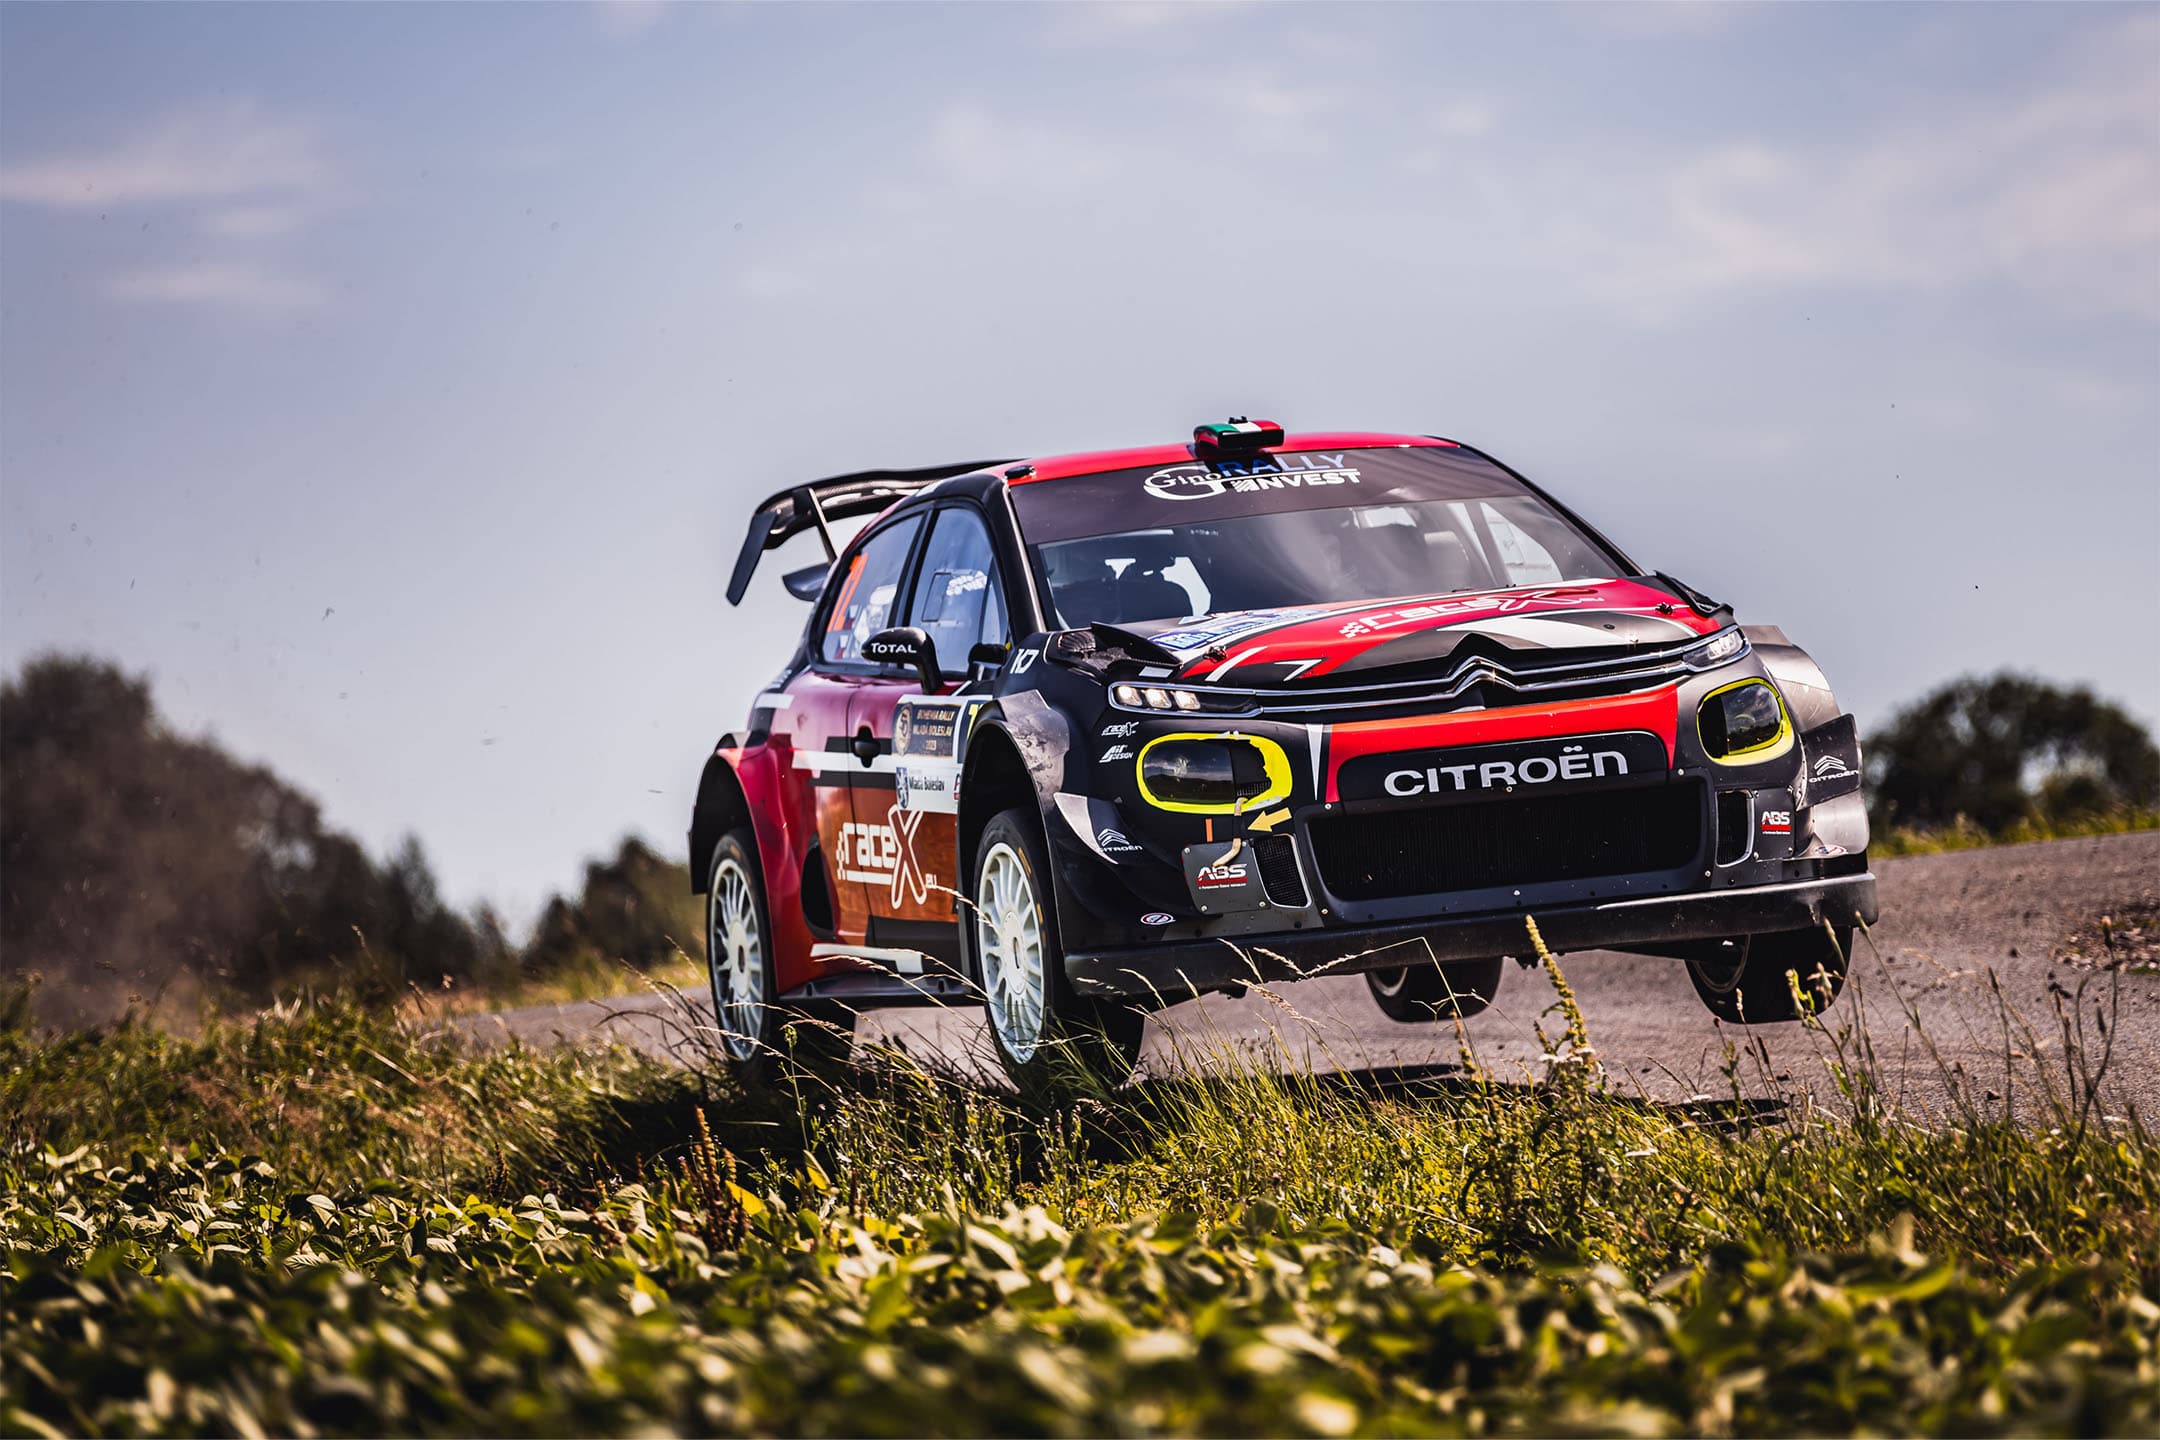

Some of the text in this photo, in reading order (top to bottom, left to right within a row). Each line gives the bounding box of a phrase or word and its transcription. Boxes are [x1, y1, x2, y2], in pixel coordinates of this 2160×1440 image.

[1215, 454, 1345, 477] RALLY
[1143, 470, 1223, 490] Gino
[871, 643, 917, 654] TOTAL
[1383, 745, 1629, 797] CITROËN
[1761, 811, 1791, 825] ABS
[1197, 863, 1248, 881] ABS
